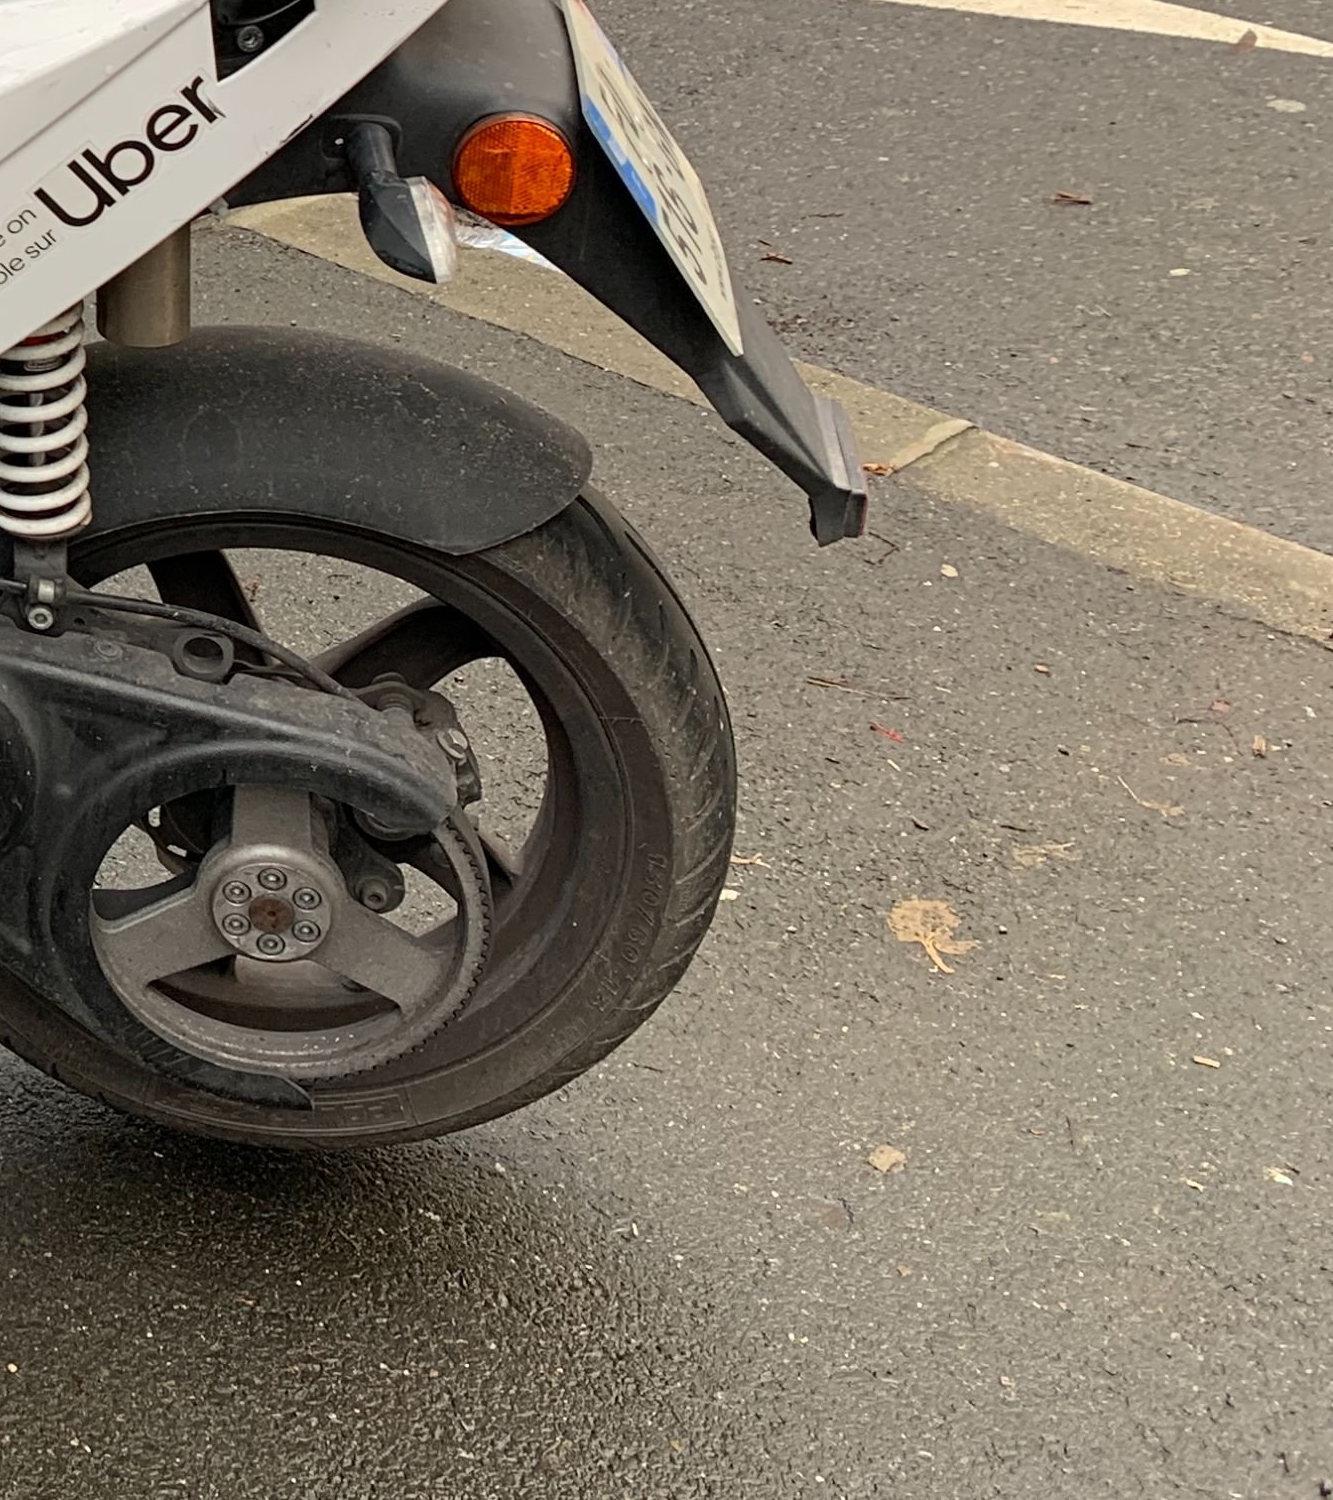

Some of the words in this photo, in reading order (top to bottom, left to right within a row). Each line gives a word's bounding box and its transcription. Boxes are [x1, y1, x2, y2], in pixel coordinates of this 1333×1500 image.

[33, 75, 218, 228] Uber
[6, 208, 38, 235] on
[24, 229, 58, 259] sur
